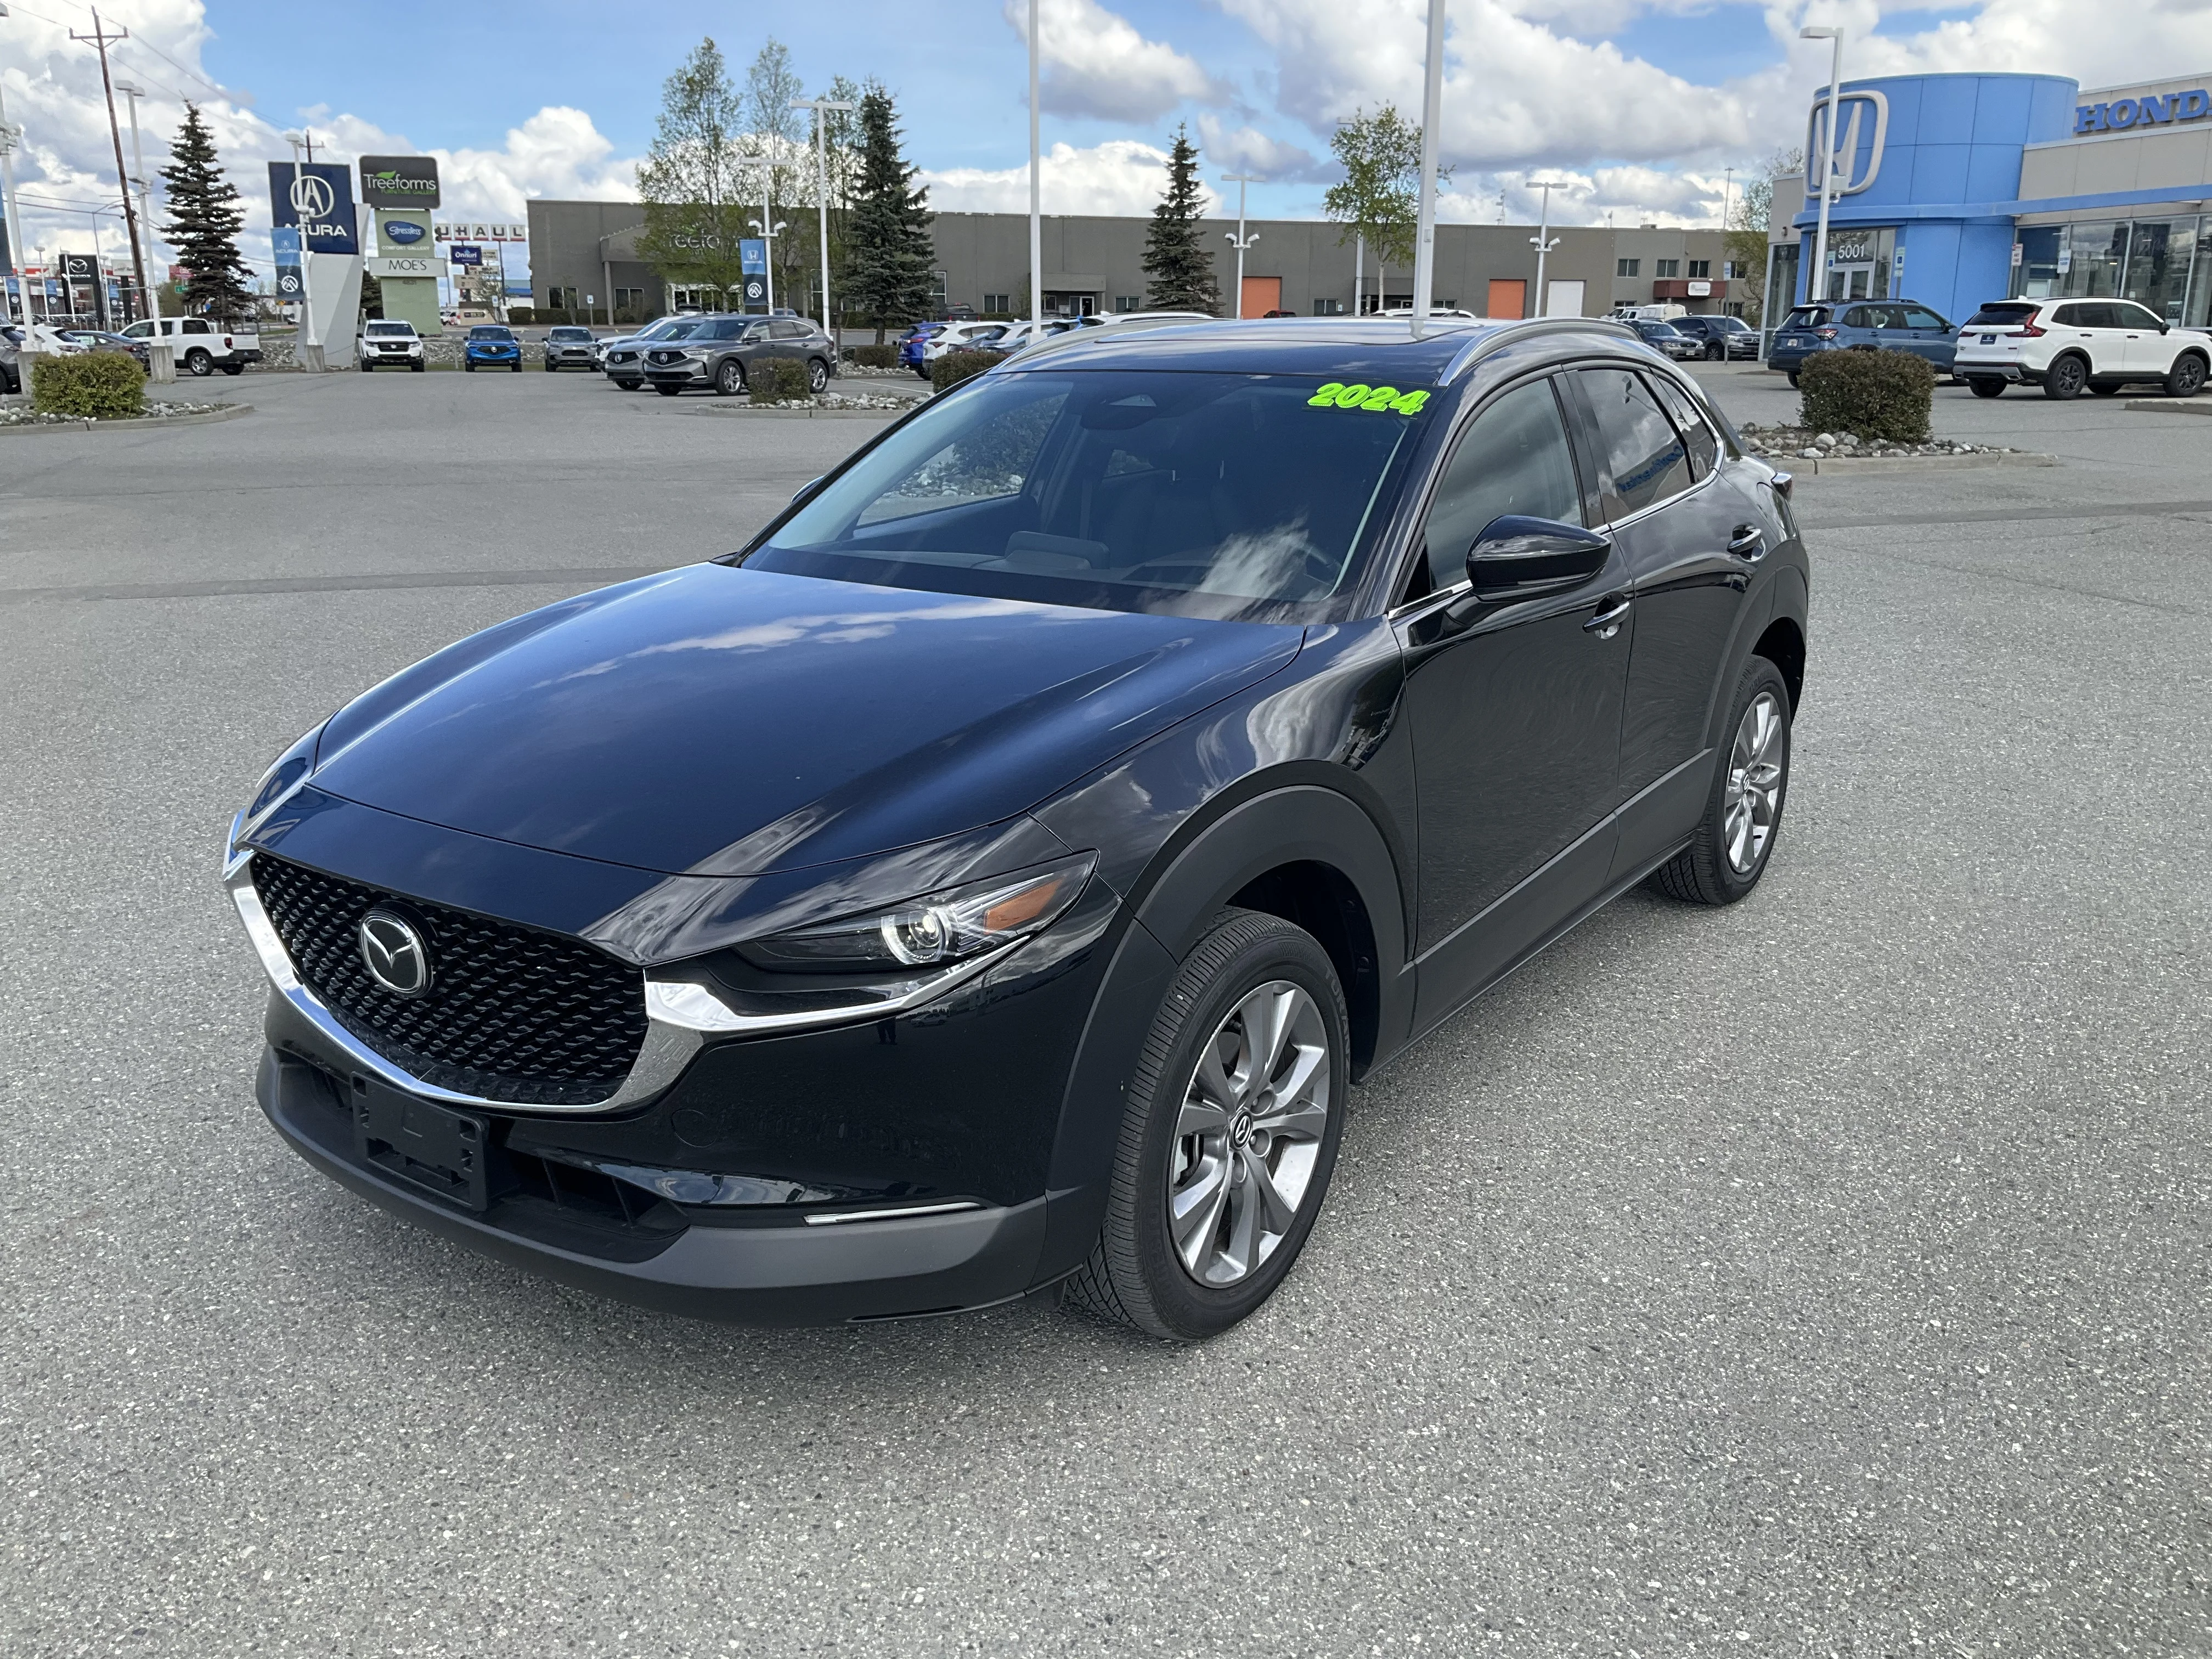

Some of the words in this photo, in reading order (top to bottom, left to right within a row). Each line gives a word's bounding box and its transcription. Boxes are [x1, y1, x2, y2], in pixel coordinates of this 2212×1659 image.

[2073, 88, 2212, 132] HOND
[363, 173, 437, 190] Treeforms
[389, 226, 421, 235] Stressless
[1838, 244, 1865, 259] 5001
[388, 259, 427, 270] MOE'S
[1307, 383, 1431, 415] 2024
